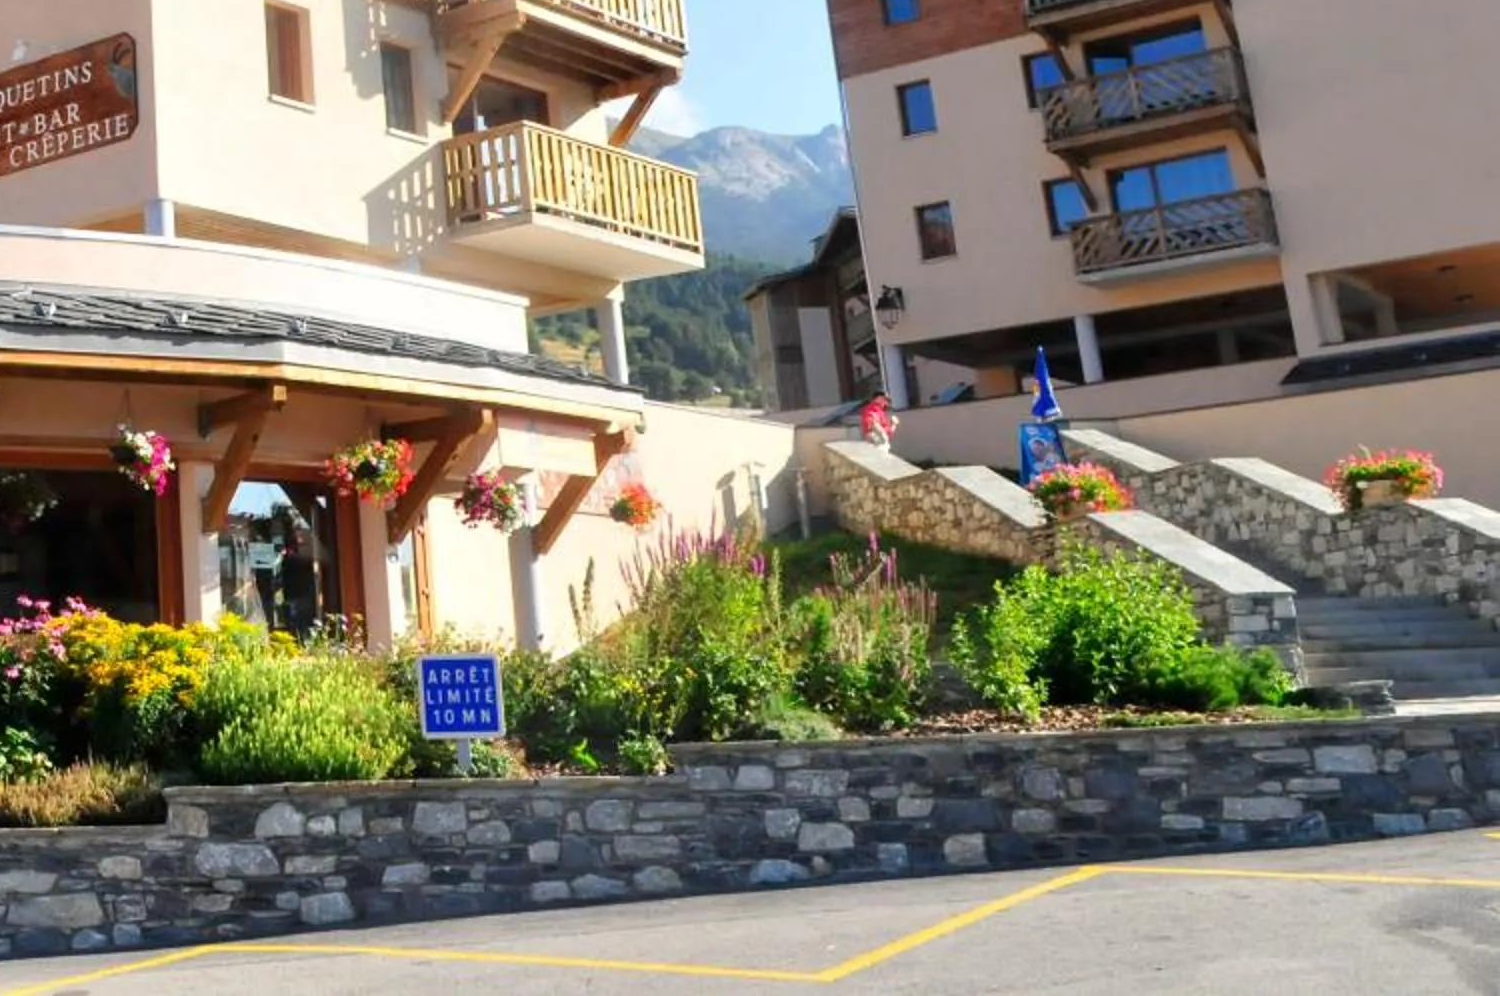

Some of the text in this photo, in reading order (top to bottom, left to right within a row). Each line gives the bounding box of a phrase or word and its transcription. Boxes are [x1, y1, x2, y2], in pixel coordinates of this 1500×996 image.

[33, 102, 81, 135] BAR
[8, 112, 131, 168] CRÊPERIE
[433, 708, 492, 725] 10 MN
